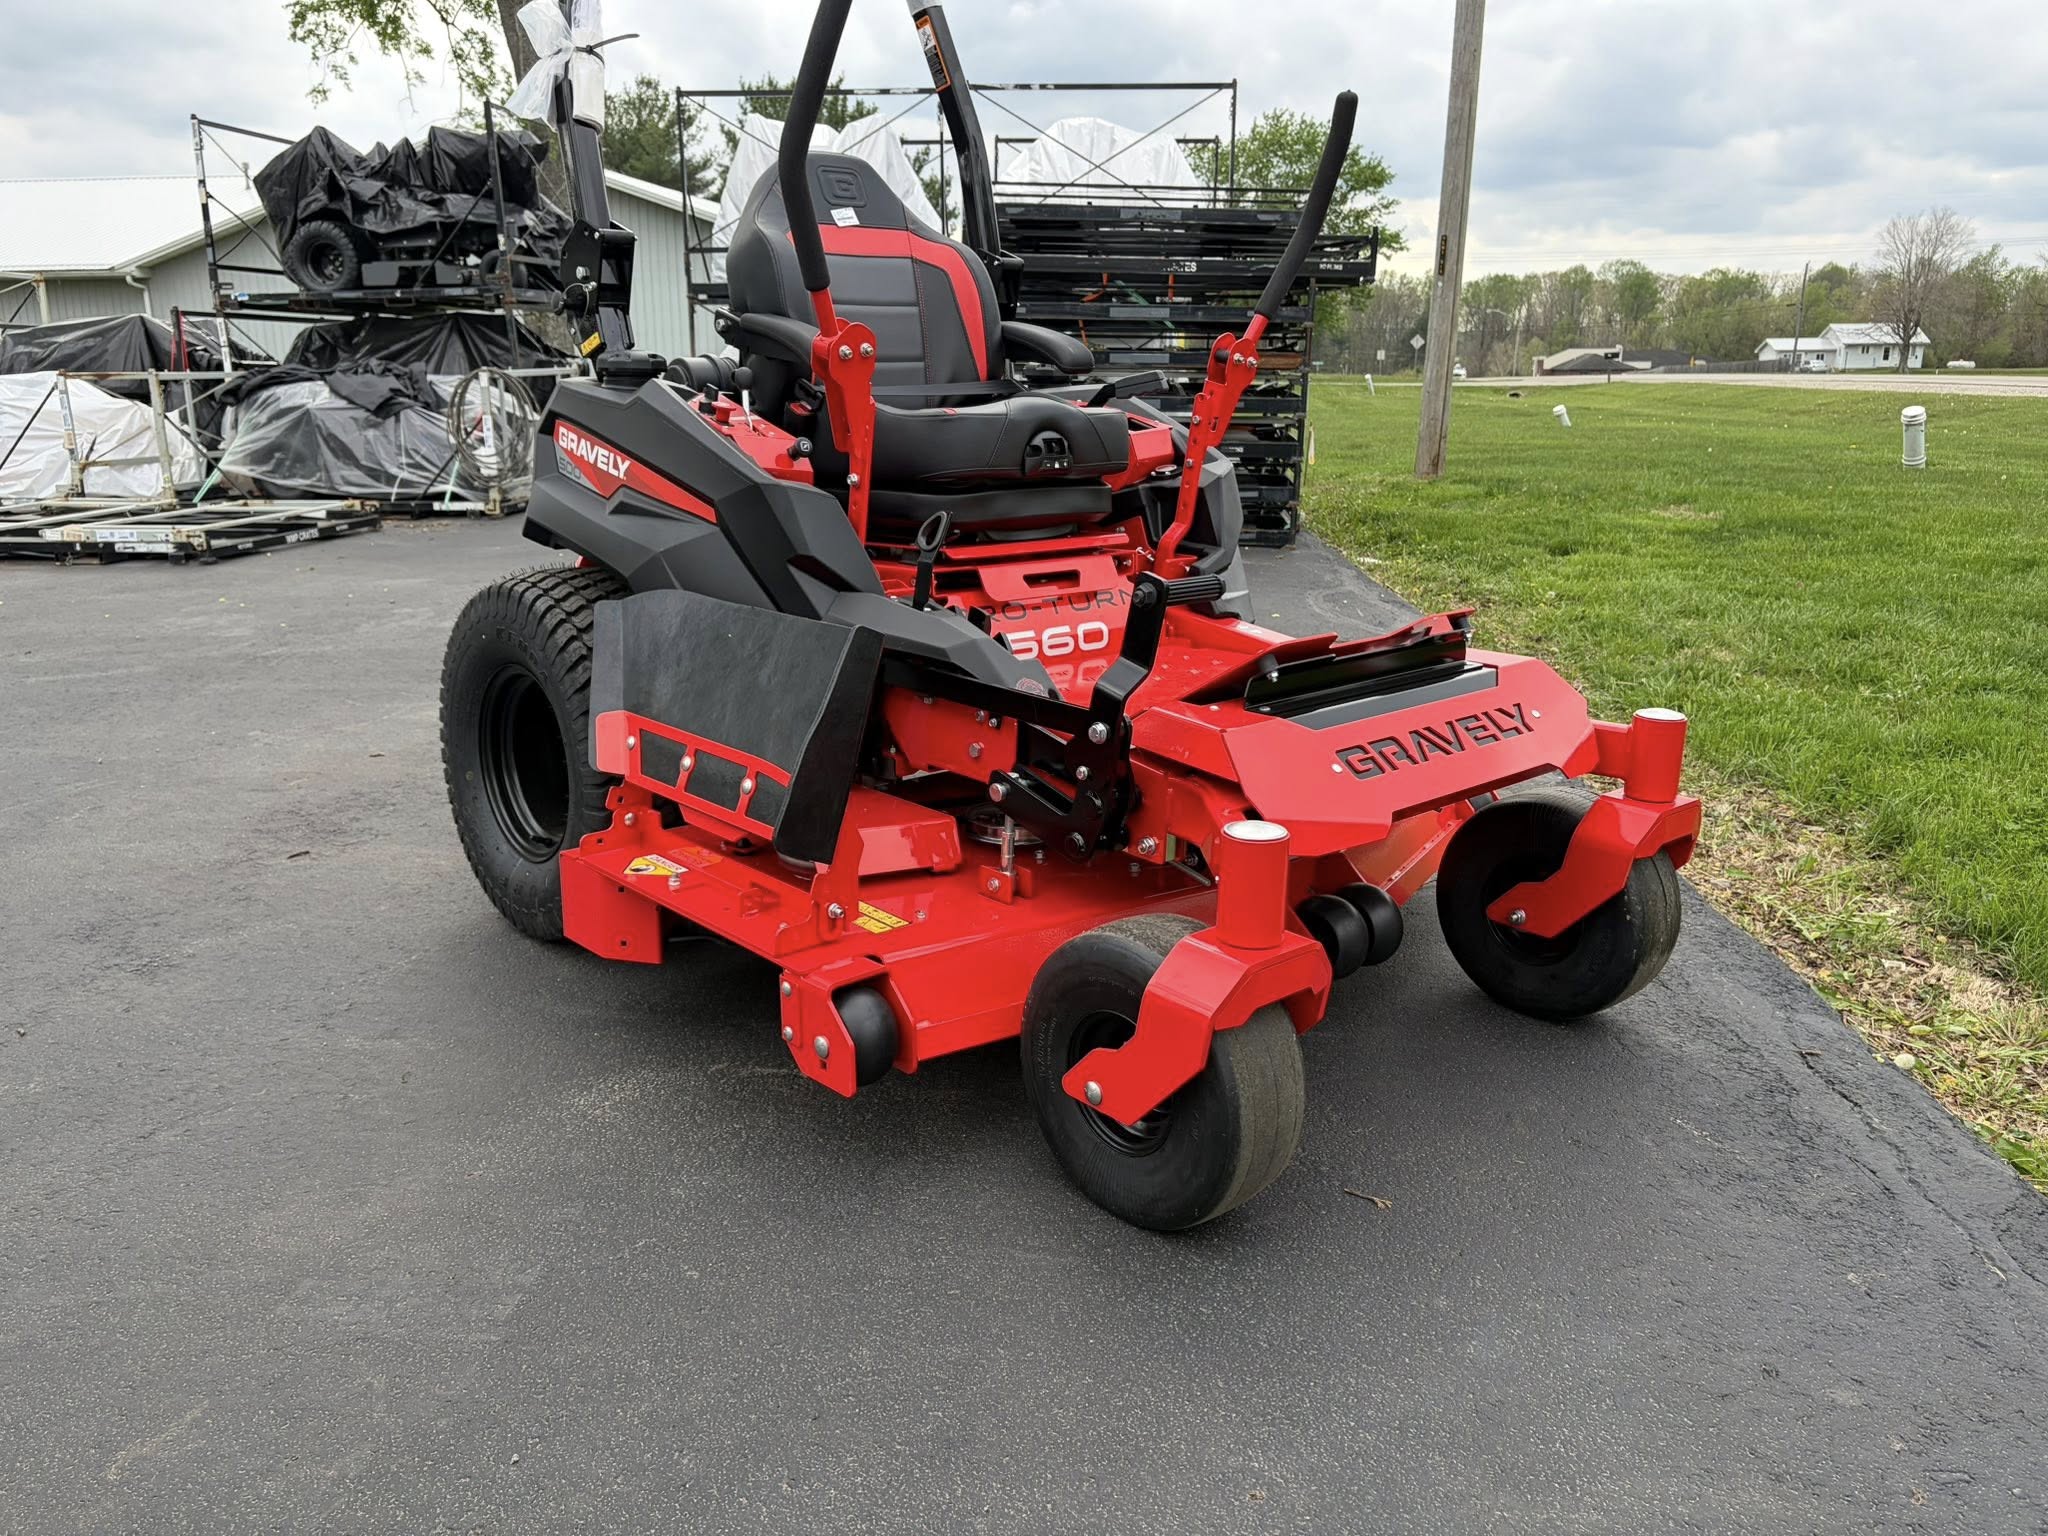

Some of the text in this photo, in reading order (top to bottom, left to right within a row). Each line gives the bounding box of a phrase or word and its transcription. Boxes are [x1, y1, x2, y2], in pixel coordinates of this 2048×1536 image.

[558, 425, 631, 480] GRAVELY
[1006, 621, 1109, 661] 560
[1335, 703, 1534, 780] GRAVELY
